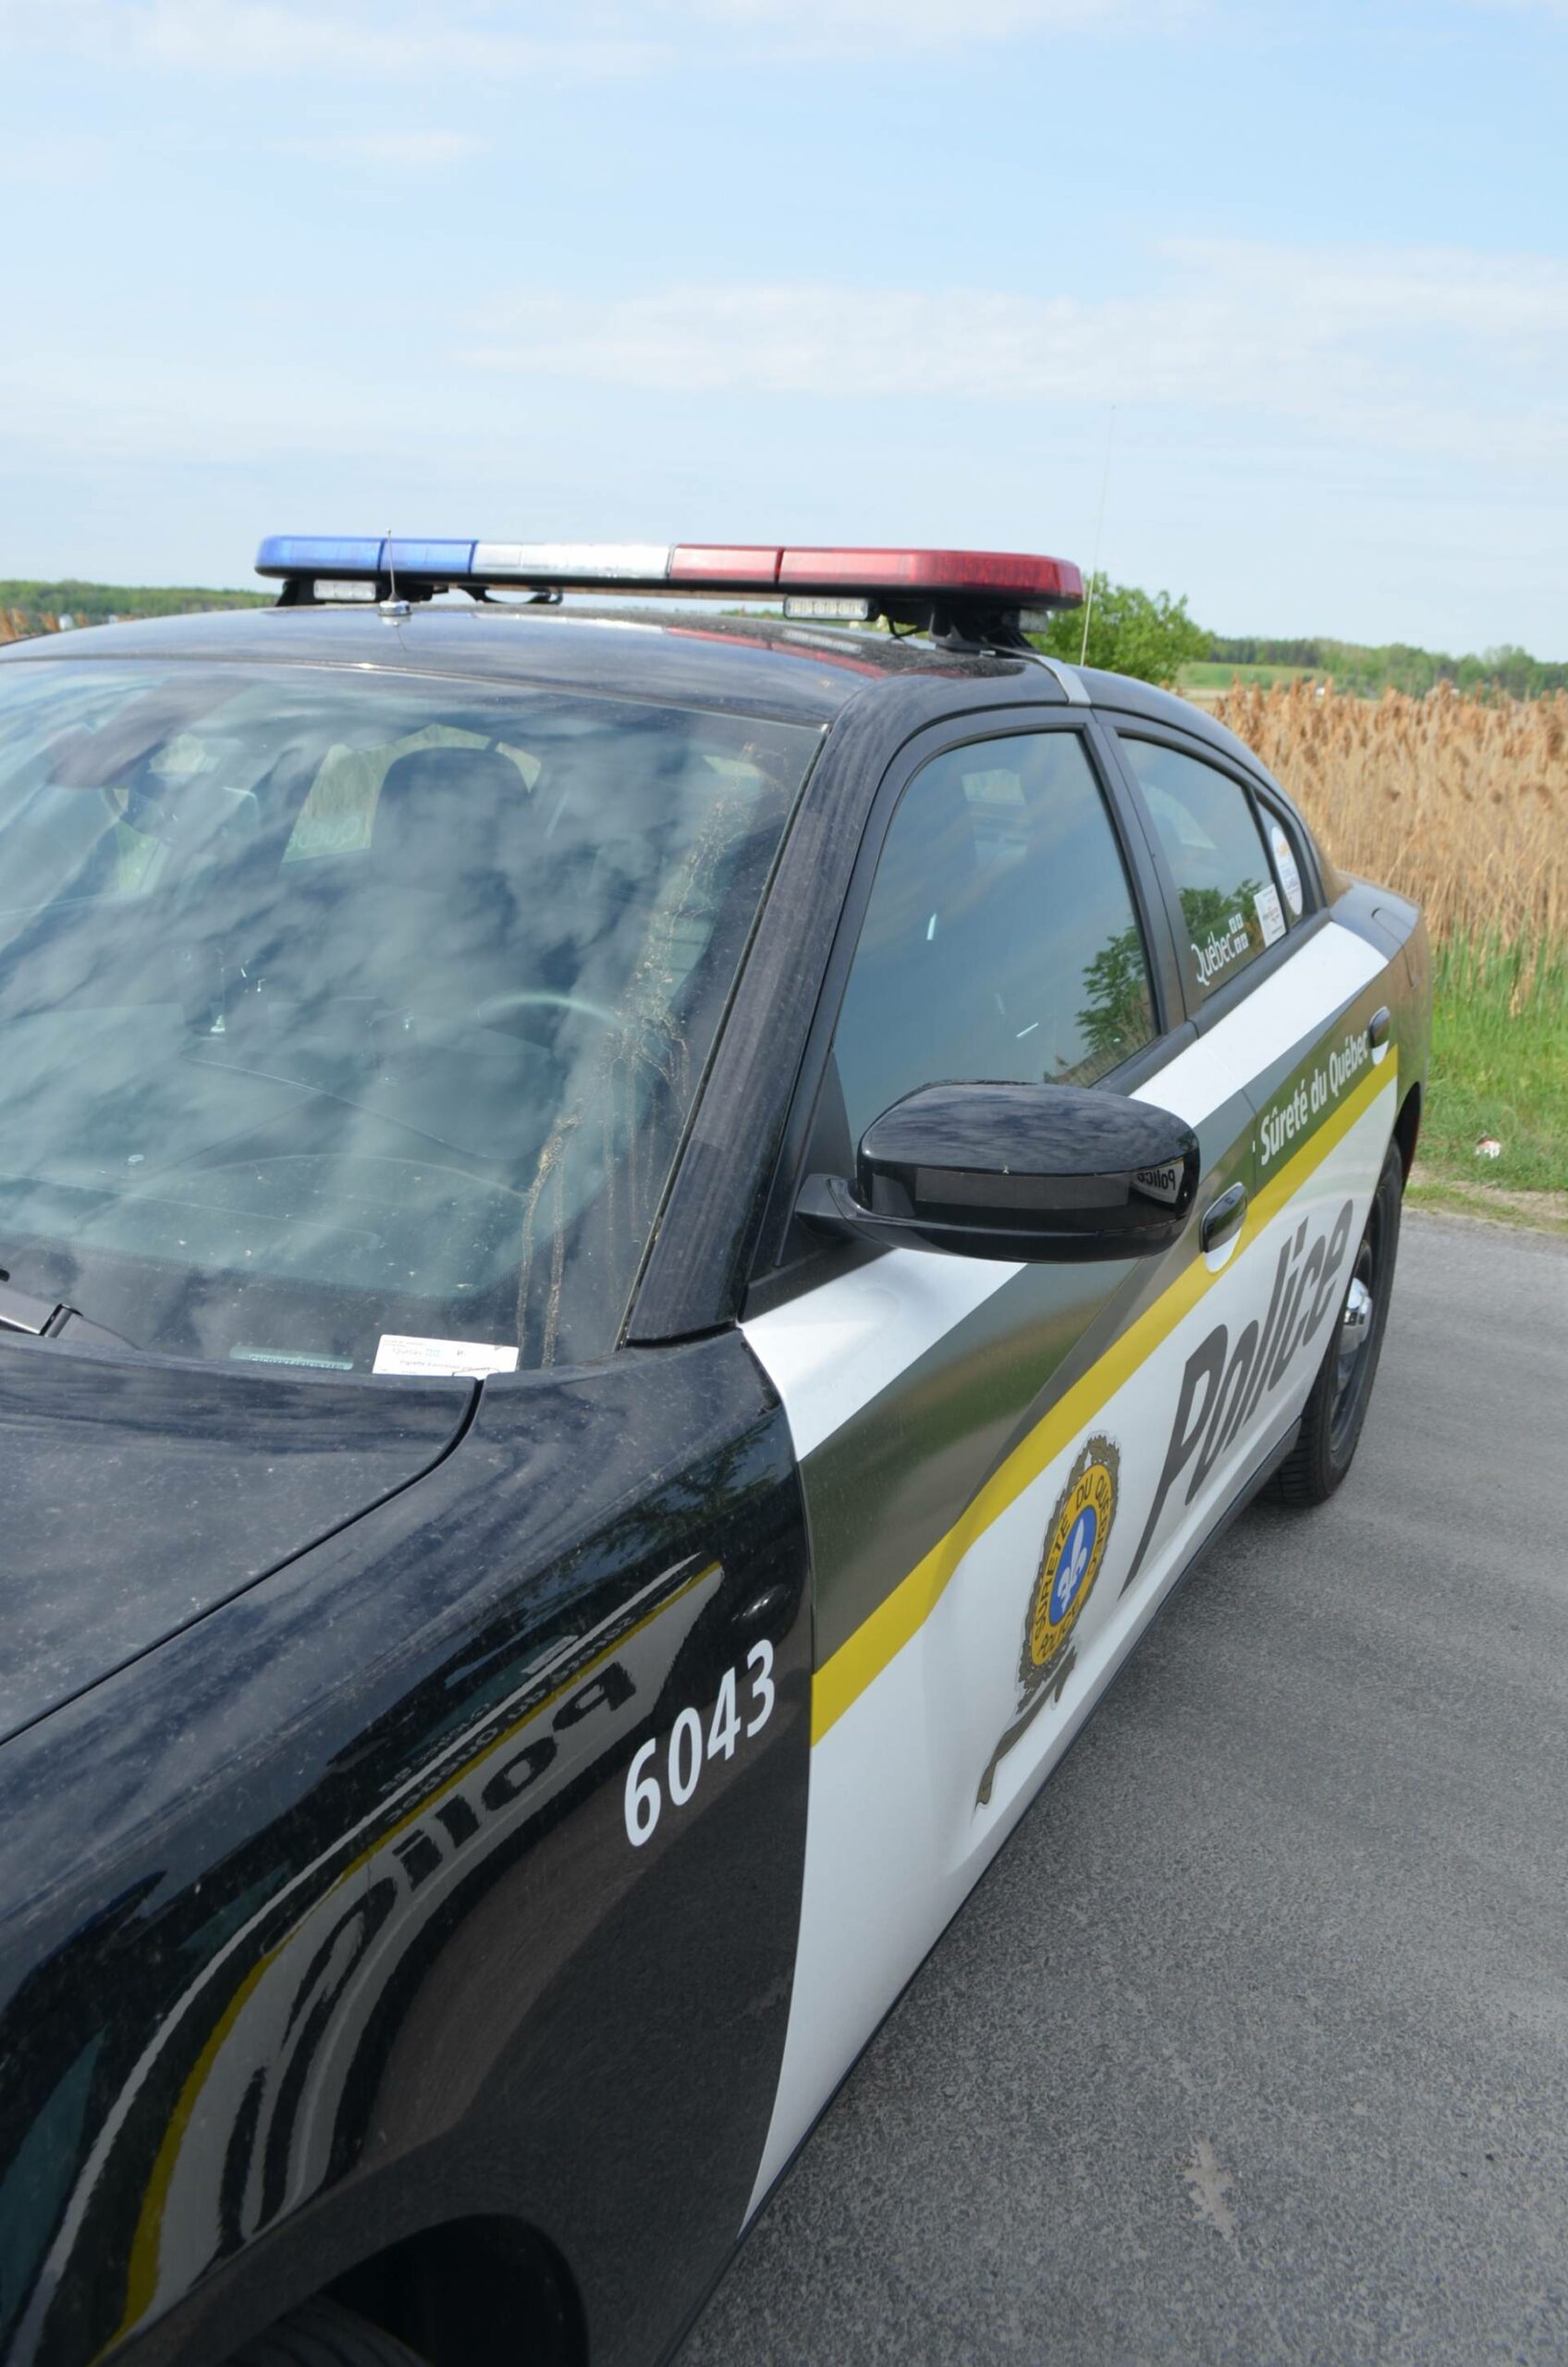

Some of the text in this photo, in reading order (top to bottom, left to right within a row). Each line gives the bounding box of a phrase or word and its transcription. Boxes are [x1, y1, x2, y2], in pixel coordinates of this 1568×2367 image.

[1191, 934, 1236, 987] Québec
[1260, 1030, 1369, 1166] Sûreté du Québec
[1118, 1199, 1354, 1600] Police
[1075, 1477, 1092, 1510] DU
[624, 1638, 775, 1847] 6043
